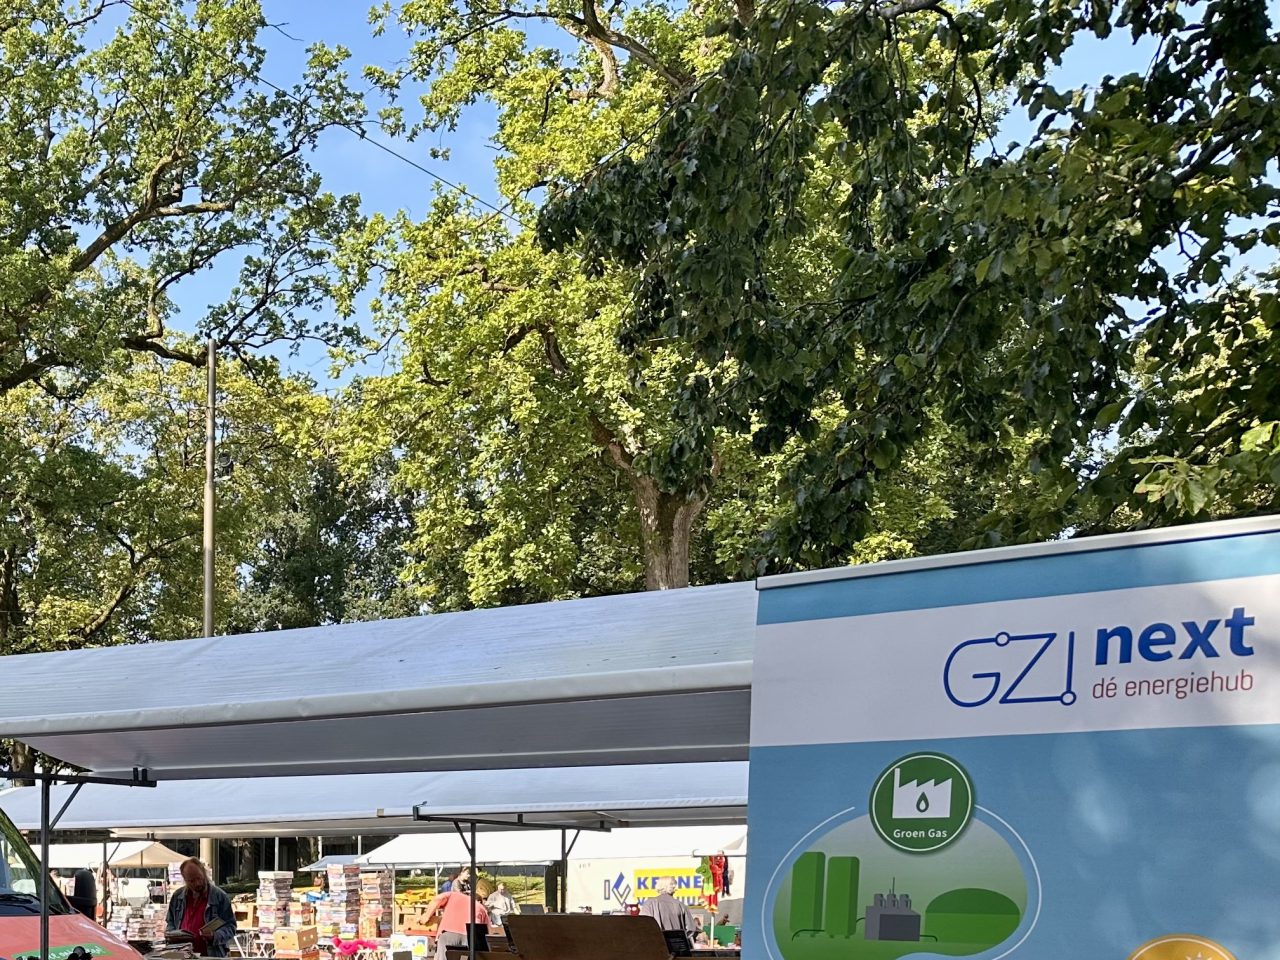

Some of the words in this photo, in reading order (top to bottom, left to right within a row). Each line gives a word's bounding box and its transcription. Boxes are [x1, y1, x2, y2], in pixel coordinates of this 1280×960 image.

[943, 631, 1077, 708] GZI
[1095, 607, 1255, 666] next
[1092, 677, 1118, 699] dé
[1124, 669, 1254, 699] energiehub
[893, 829, 925, 838] Groen
[927, 829, 948, 838] Gas
